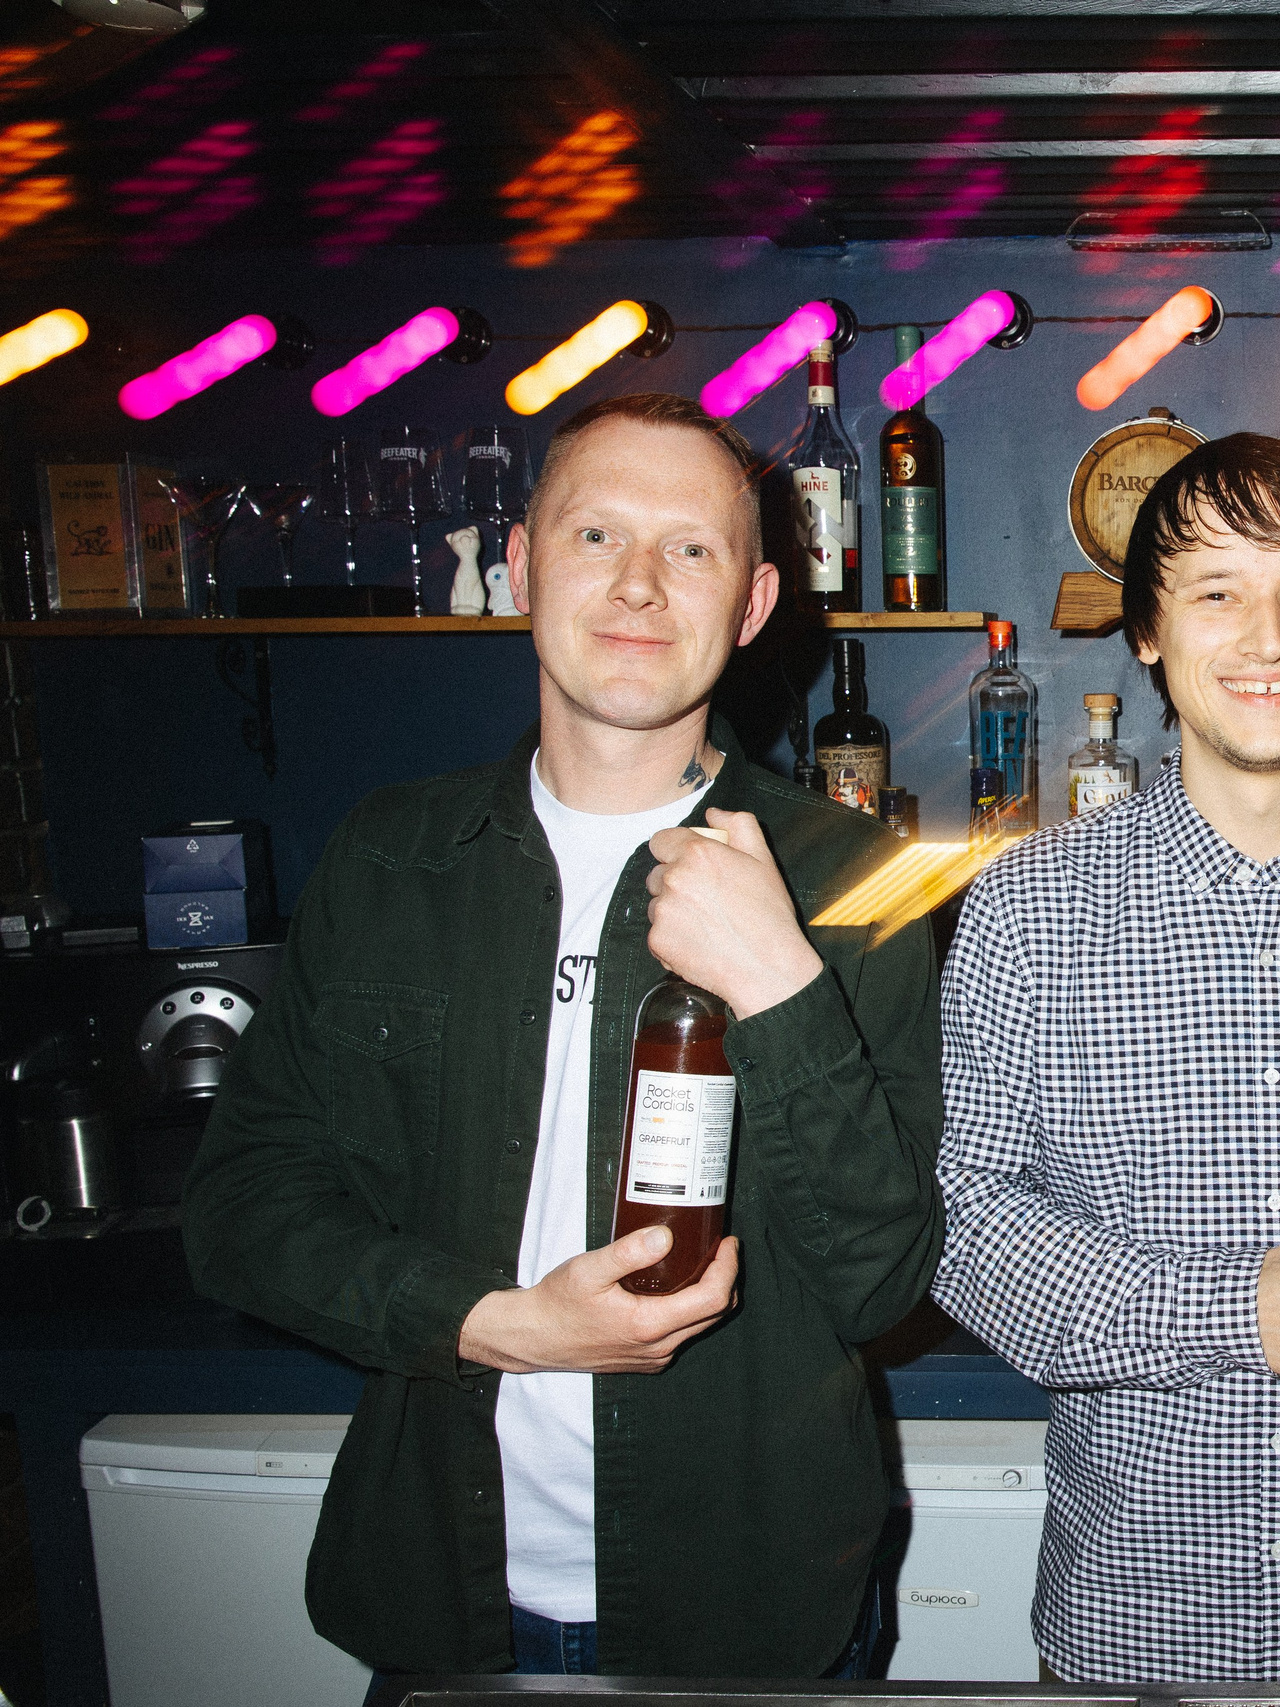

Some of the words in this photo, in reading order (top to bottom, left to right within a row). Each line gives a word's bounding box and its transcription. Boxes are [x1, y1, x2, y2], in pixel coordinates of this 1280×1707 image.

[380, 447, 418, 460] BEEFEATER
[469, 445, 506, 459] BEEFEATER
[801, 480, 830, 492] HINE
[1098, 472, 1158, 494] BARC
[144, 523, 177, 551] GIN
[818, 752, 832, 760] DEL
[832, 750, 882, 761] PROFESSORE
[977, 794, 997, 806] APEROL
[176, 960, 219, 971] NESPRESSO
[556, 954, 598, 1005] ST
[647, 1083, 692, 1100] Rocket
[642, 1096, 695, 1113] Cordials
[638, 1133, 691, 1146] GRAPEFRUIT
[910, 1590, 967, 1606] бирюса
